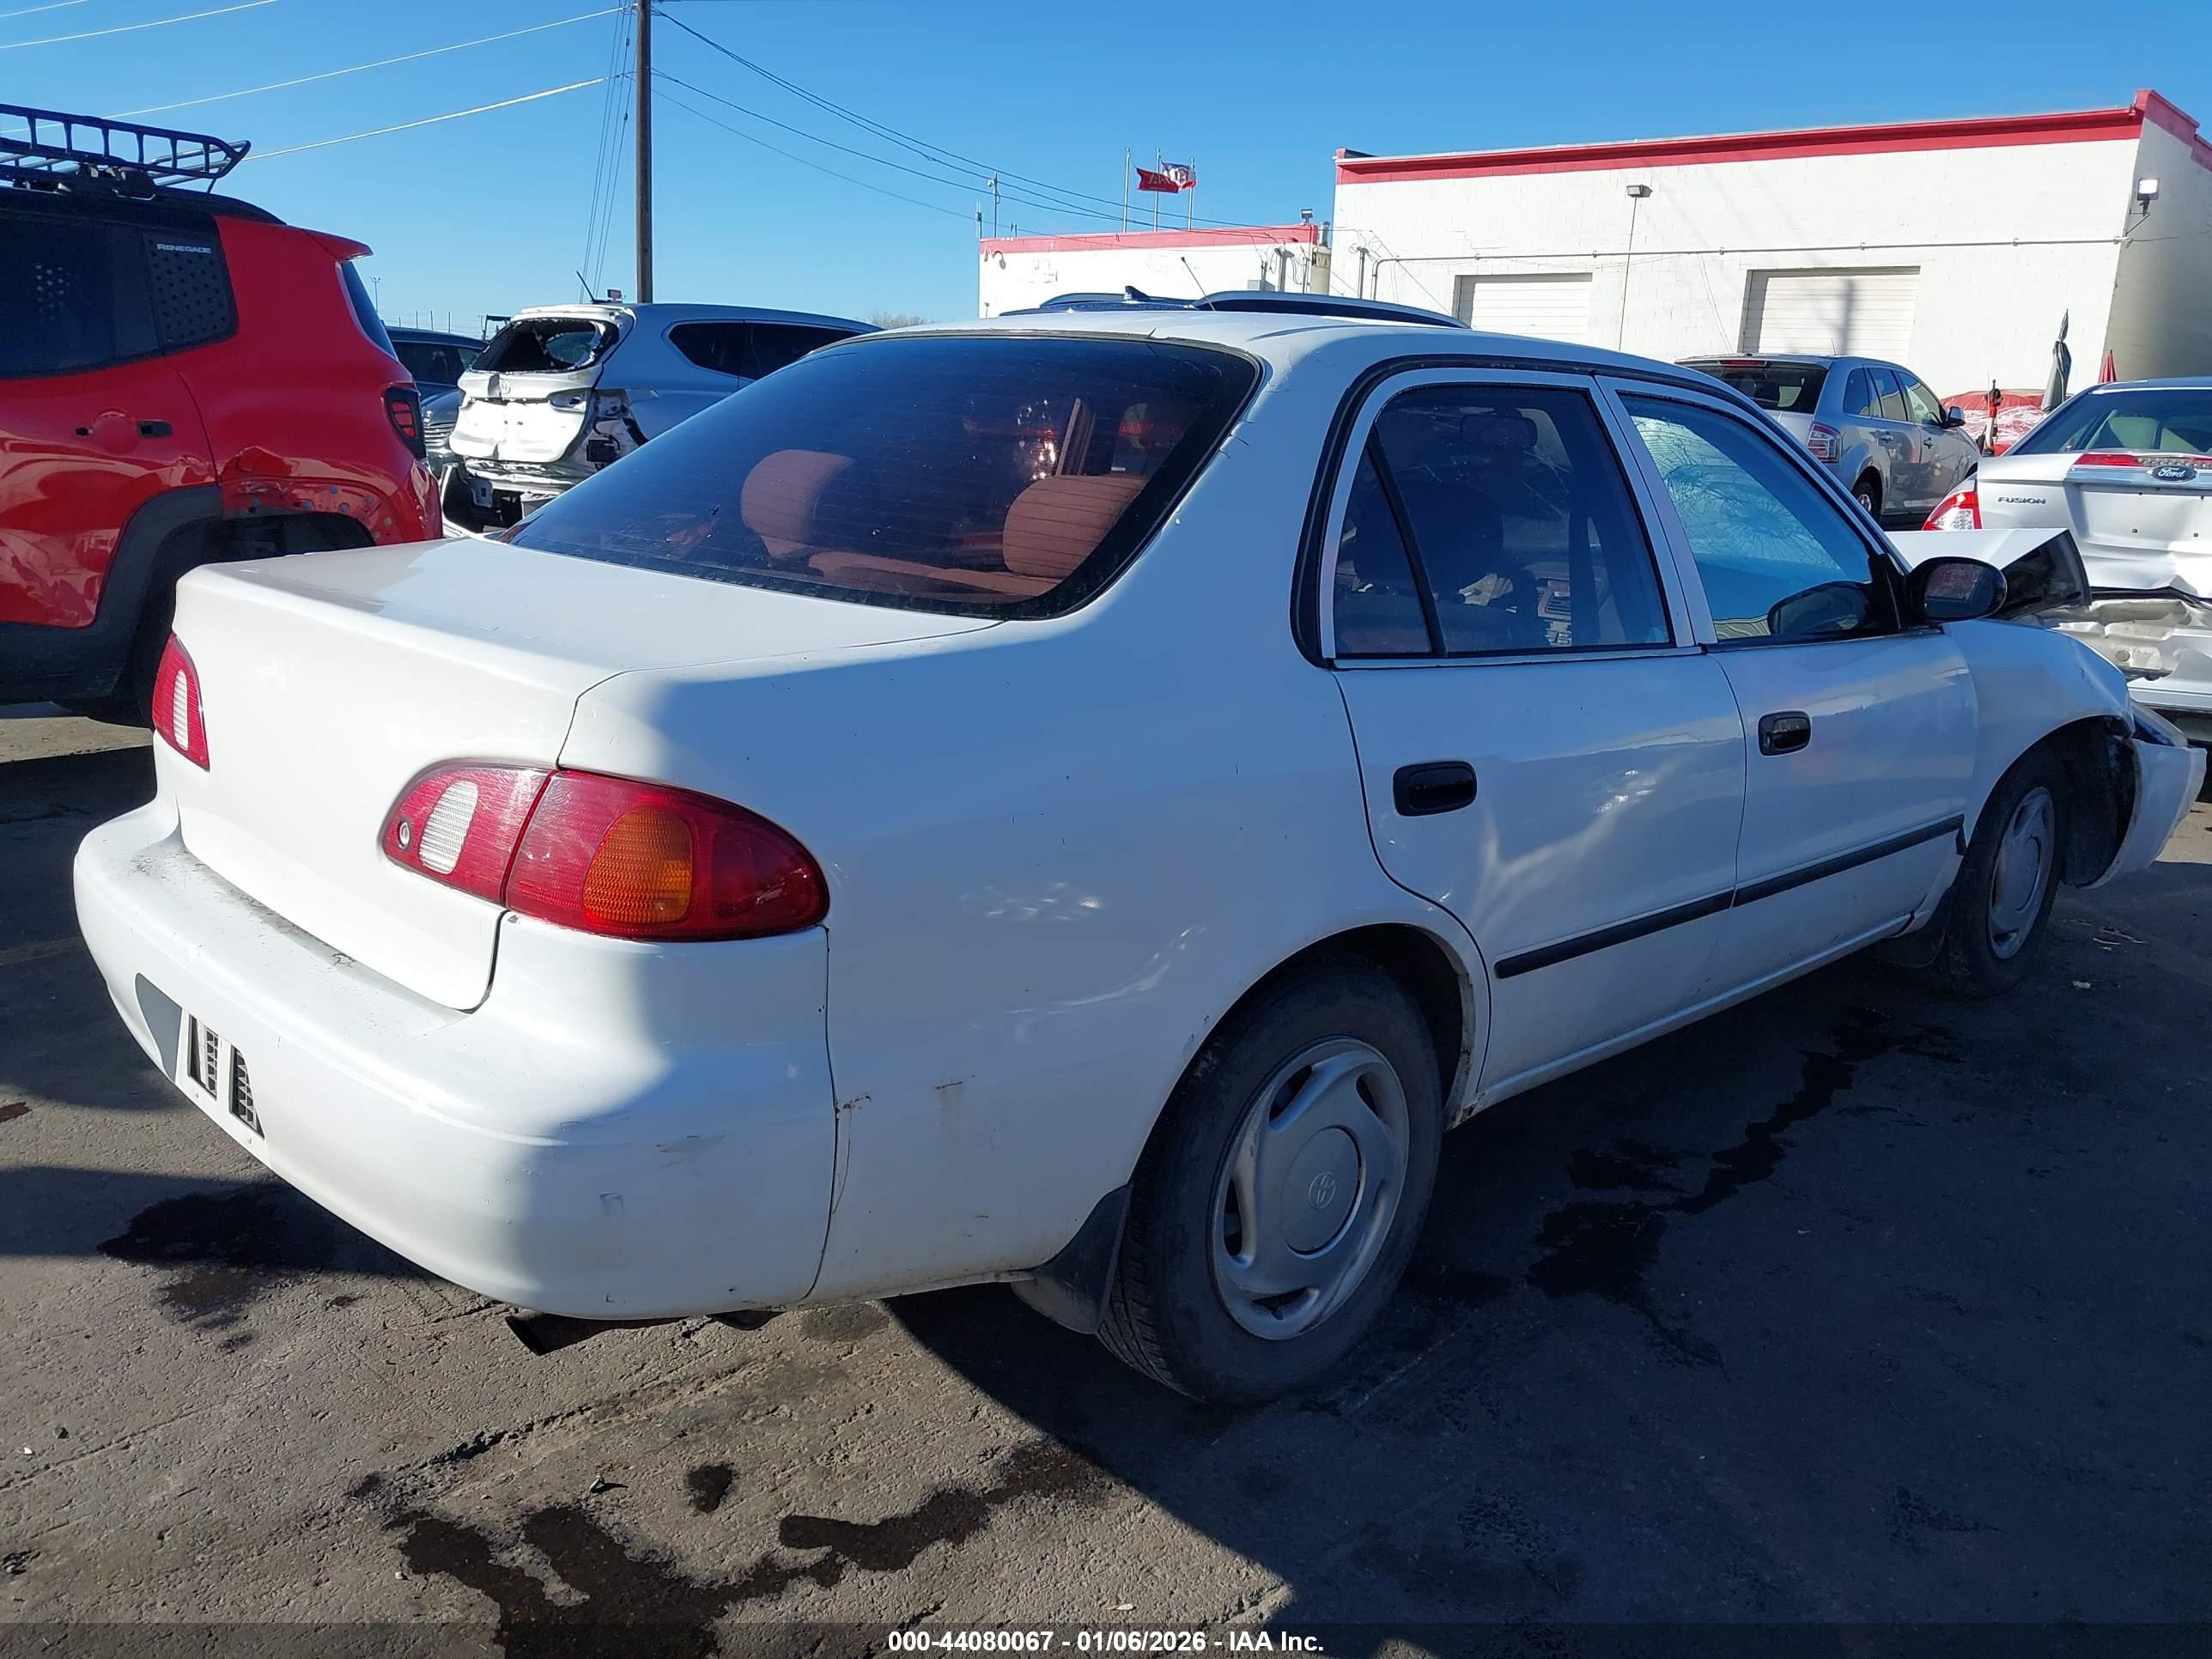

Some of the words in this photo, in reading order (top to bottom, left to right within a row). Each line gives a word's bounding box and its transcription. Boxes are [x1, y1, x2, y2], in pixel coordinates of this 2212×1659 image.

[156, 243, 211, 253] RENEGADE
[2157, 466, 2186, 477] Ford
[1997, 496, 2046, 505] FUSION
